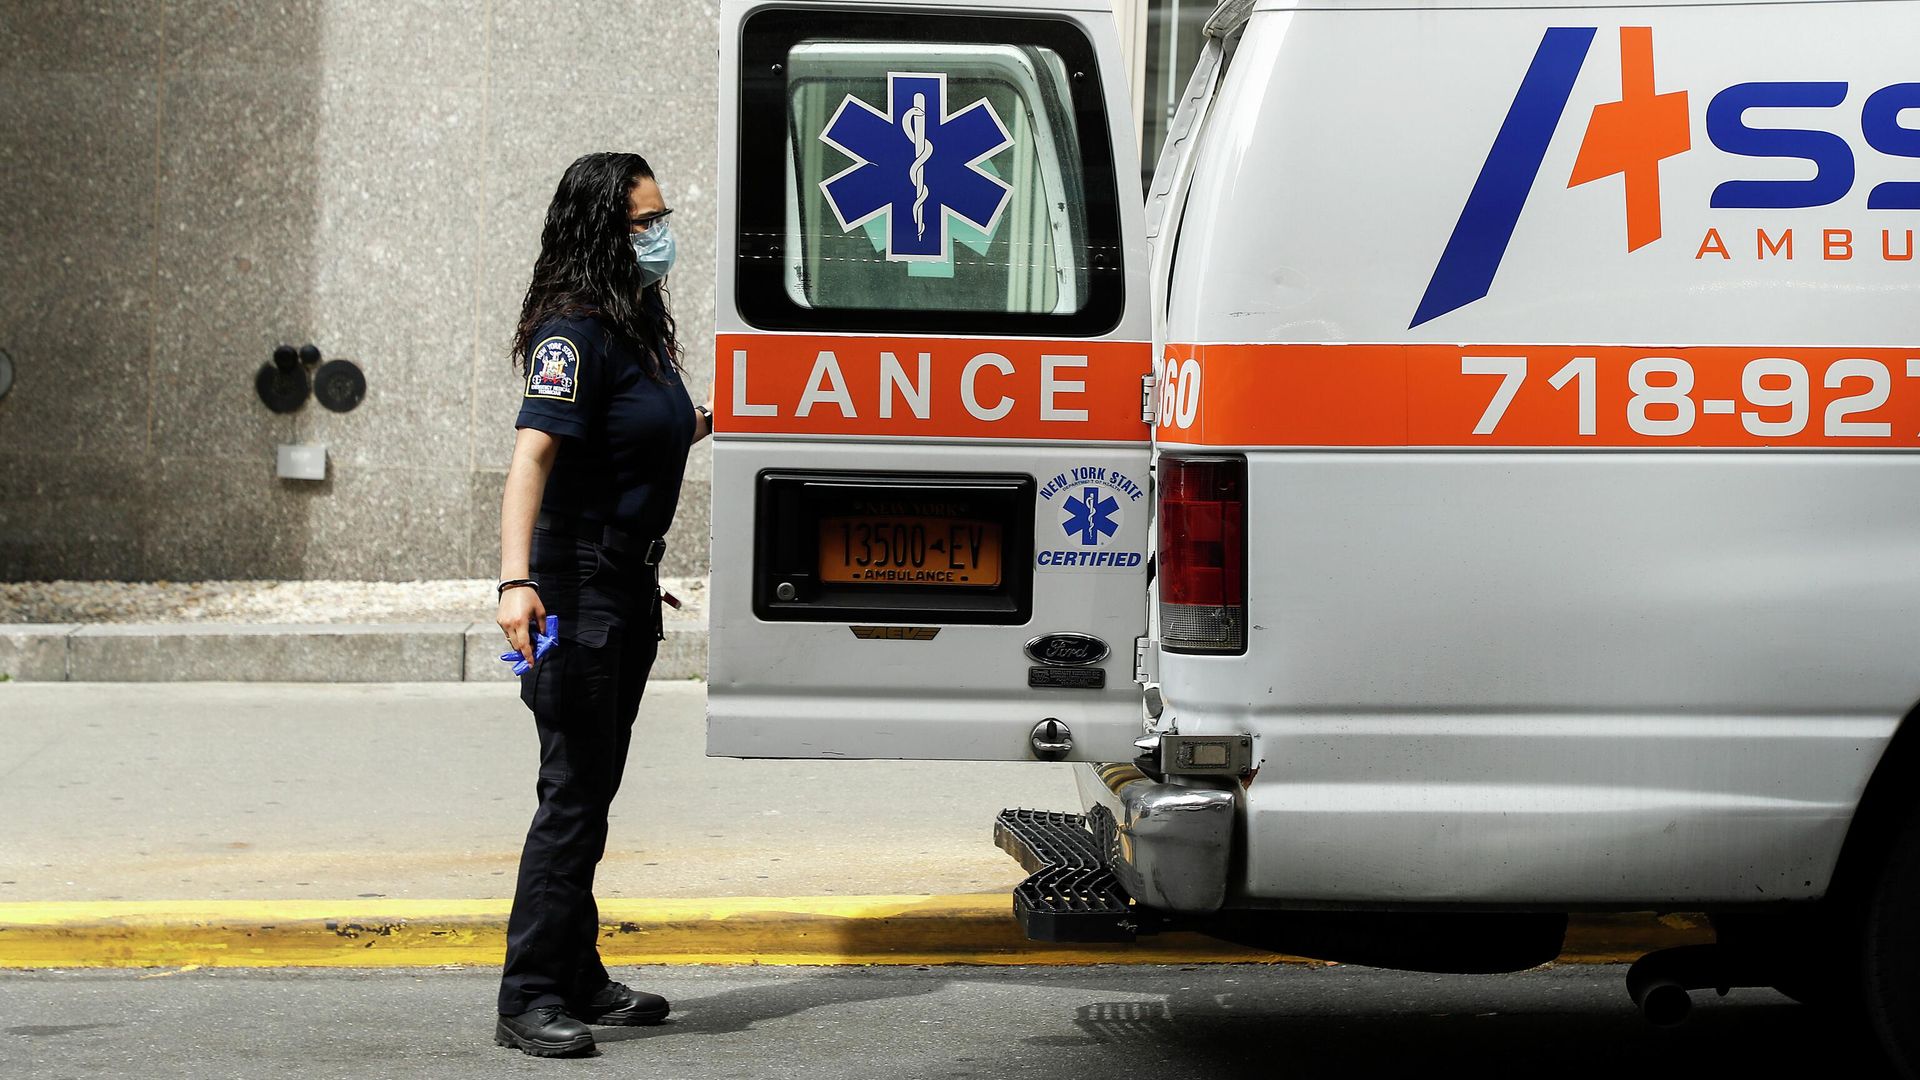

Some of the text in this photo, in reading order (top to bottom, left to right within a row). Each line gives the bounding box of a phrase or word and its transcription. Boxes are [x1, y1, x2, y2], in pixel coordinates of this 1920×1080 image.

[1695, 228, 1913, 261] AMBU
[536, 347, 547, 360] NEW
[562, 345, 576, 362] STATE
[732, 350, 1090, 422] LANCE
[1157, 357, 1201, 429] 60
[1461, 356, 1920, 437] 718-92
[1039, 466, 1144, 502] NEW YORK STATE
[1102, 481, 1121, 492] HEALTH
[843, 523, 984, 569] 13500 EV
[1037, 550, 1142, 567] CERTIFIED
[864, 569, 954, 582] AMBULANCE
[868, 626, 921, 639] AEV
[1045, 639, 1089, 658] Ford
